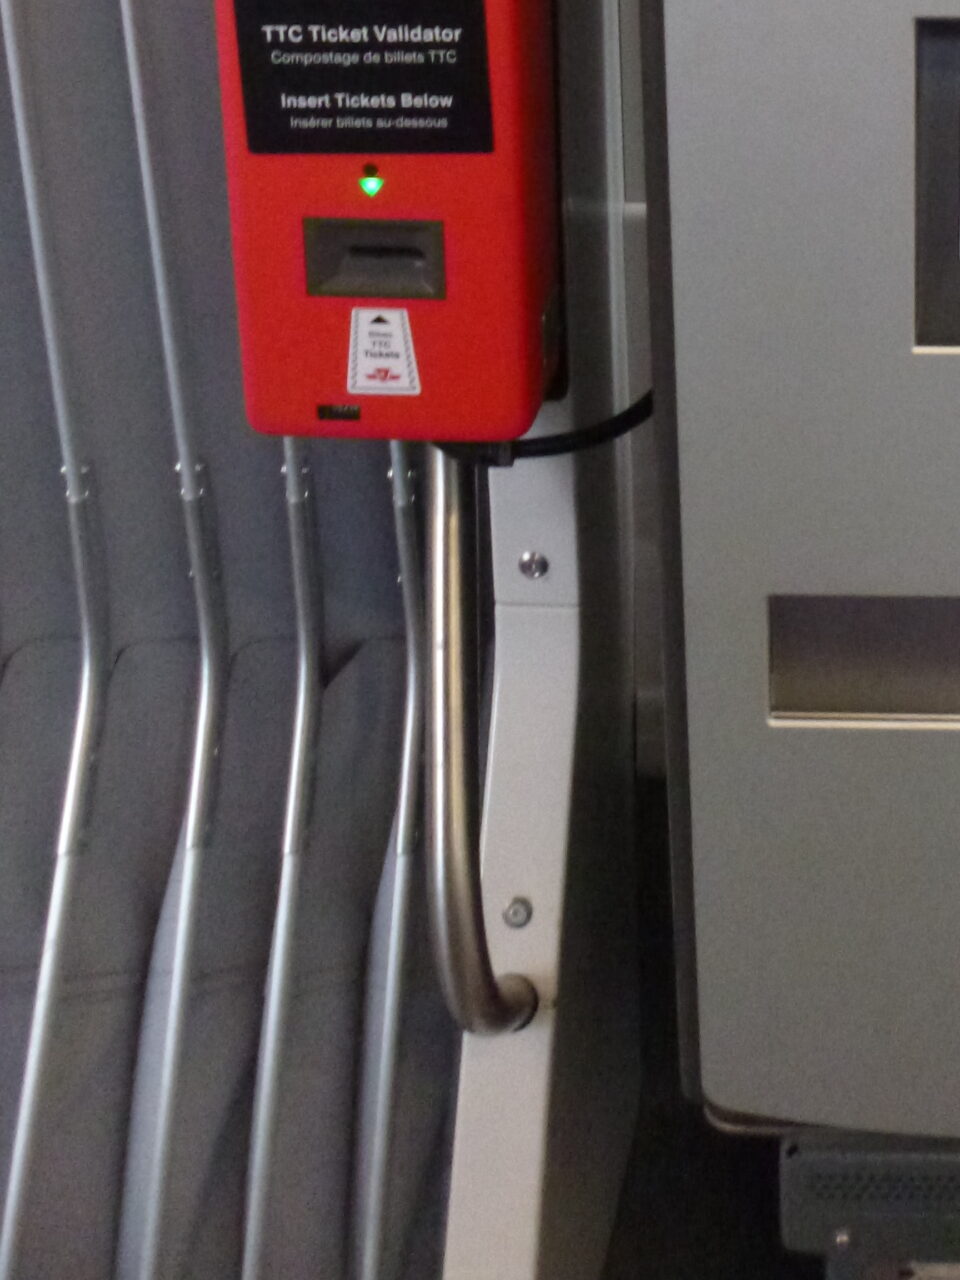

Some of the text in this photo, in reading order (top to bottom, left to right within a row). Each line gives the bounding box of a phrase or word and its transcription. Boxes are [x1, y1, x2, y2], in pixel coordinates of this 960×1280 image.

[261, 24, 463, 44] TTC Ticket Validator
[270, 49, 458, 67] Compostage de billets TTC
[280, 92, 454, 109] Insert Tickets Below
[335, 115, 373, 129] billets
